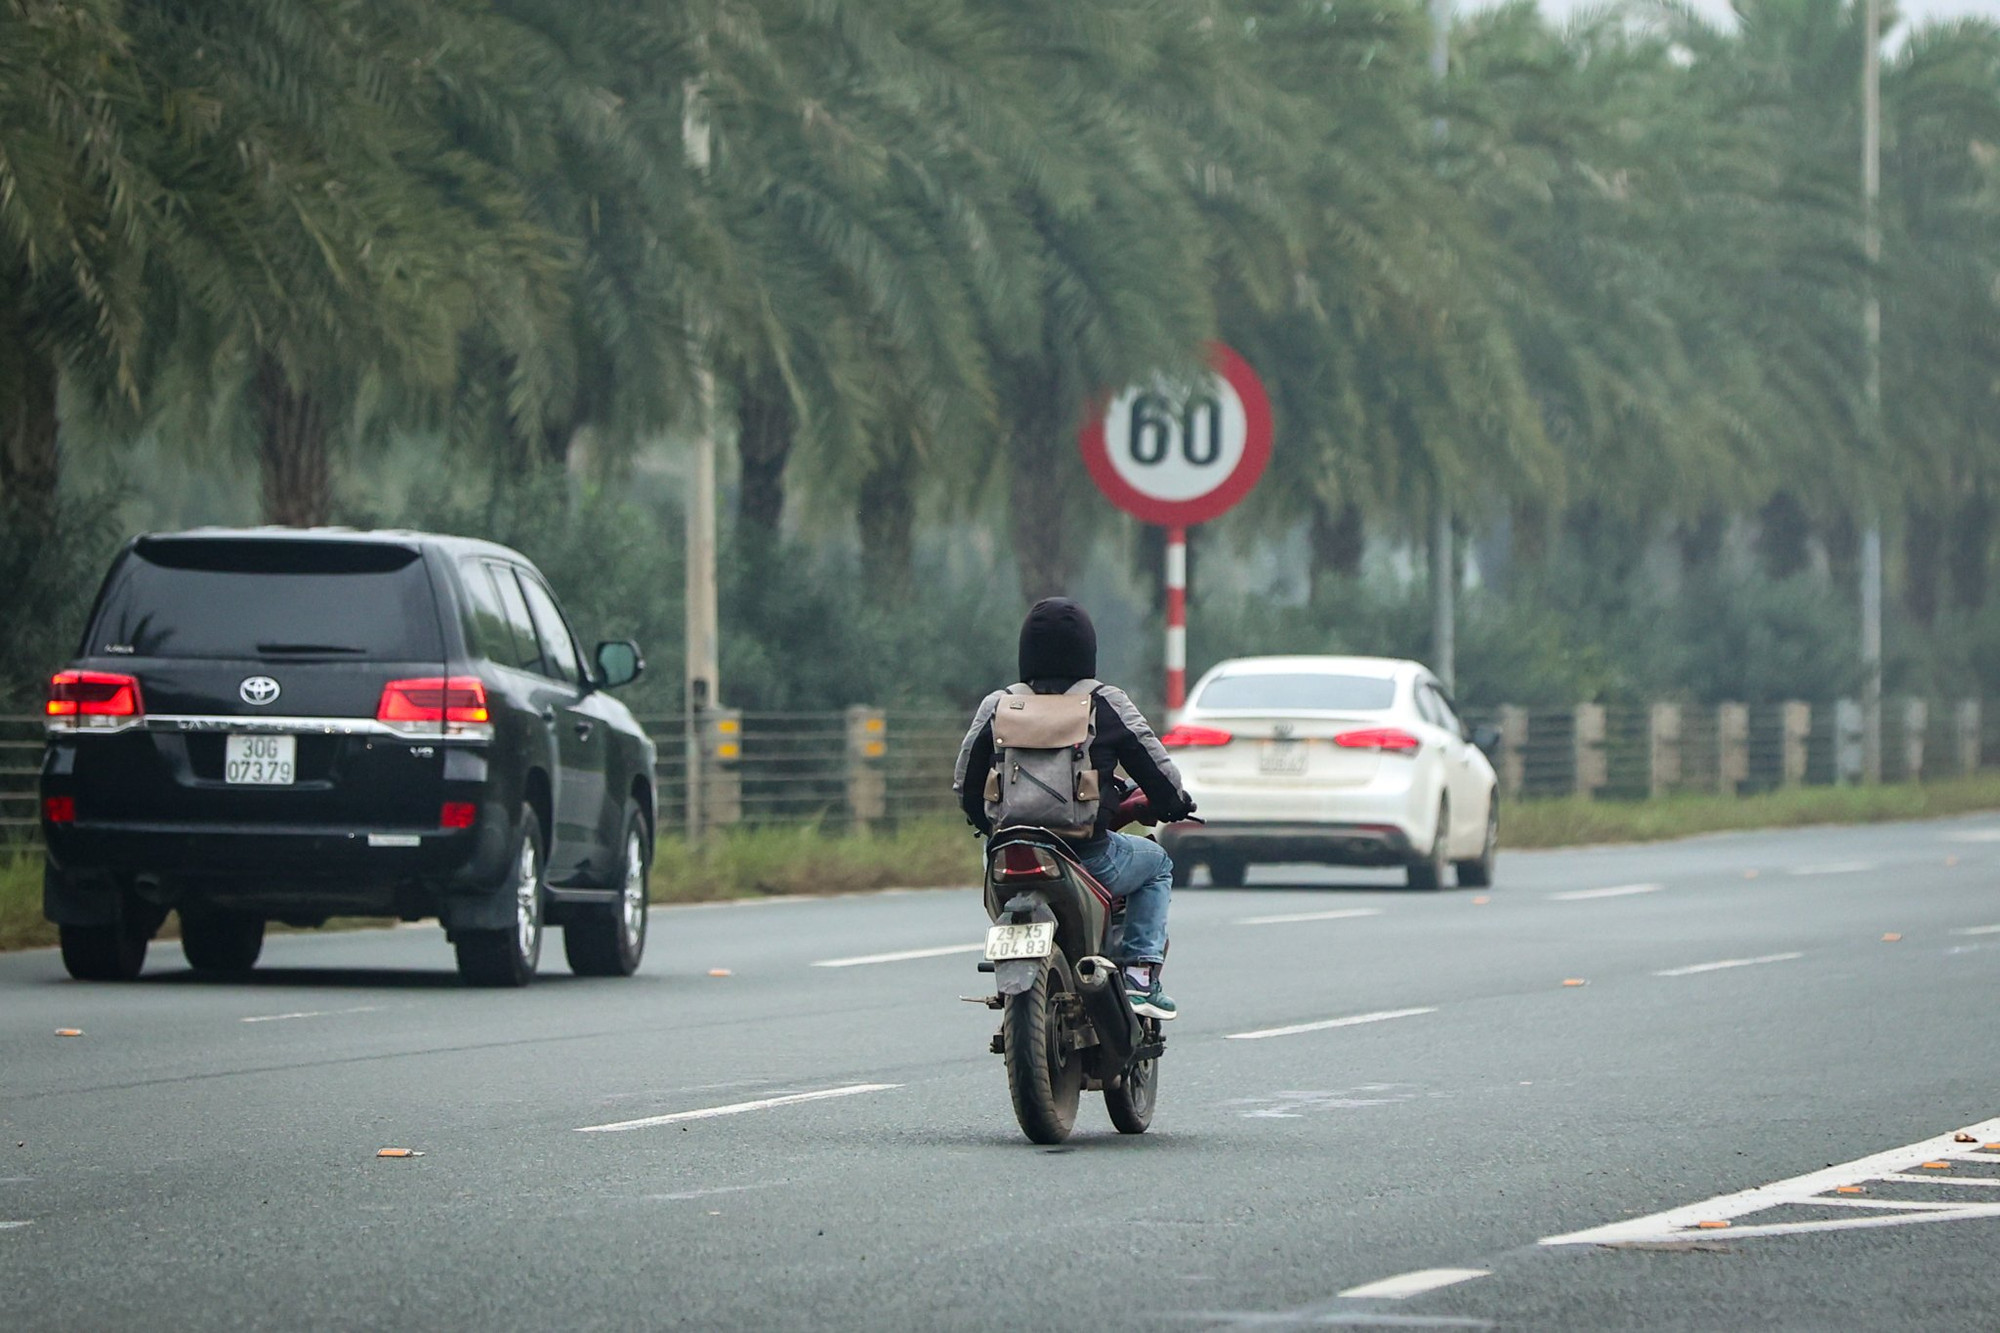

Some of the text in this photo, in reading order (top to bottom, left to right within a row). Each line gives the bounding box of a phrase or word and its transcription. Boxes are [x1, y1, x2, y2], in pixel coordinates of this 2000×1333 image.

[1130, 393, 1222, 466] 60
[242, 738, 278, 759] 30G
[996, 924, 1043, 942] 29-X5
[989, 940, 1046, 957] 404.83
